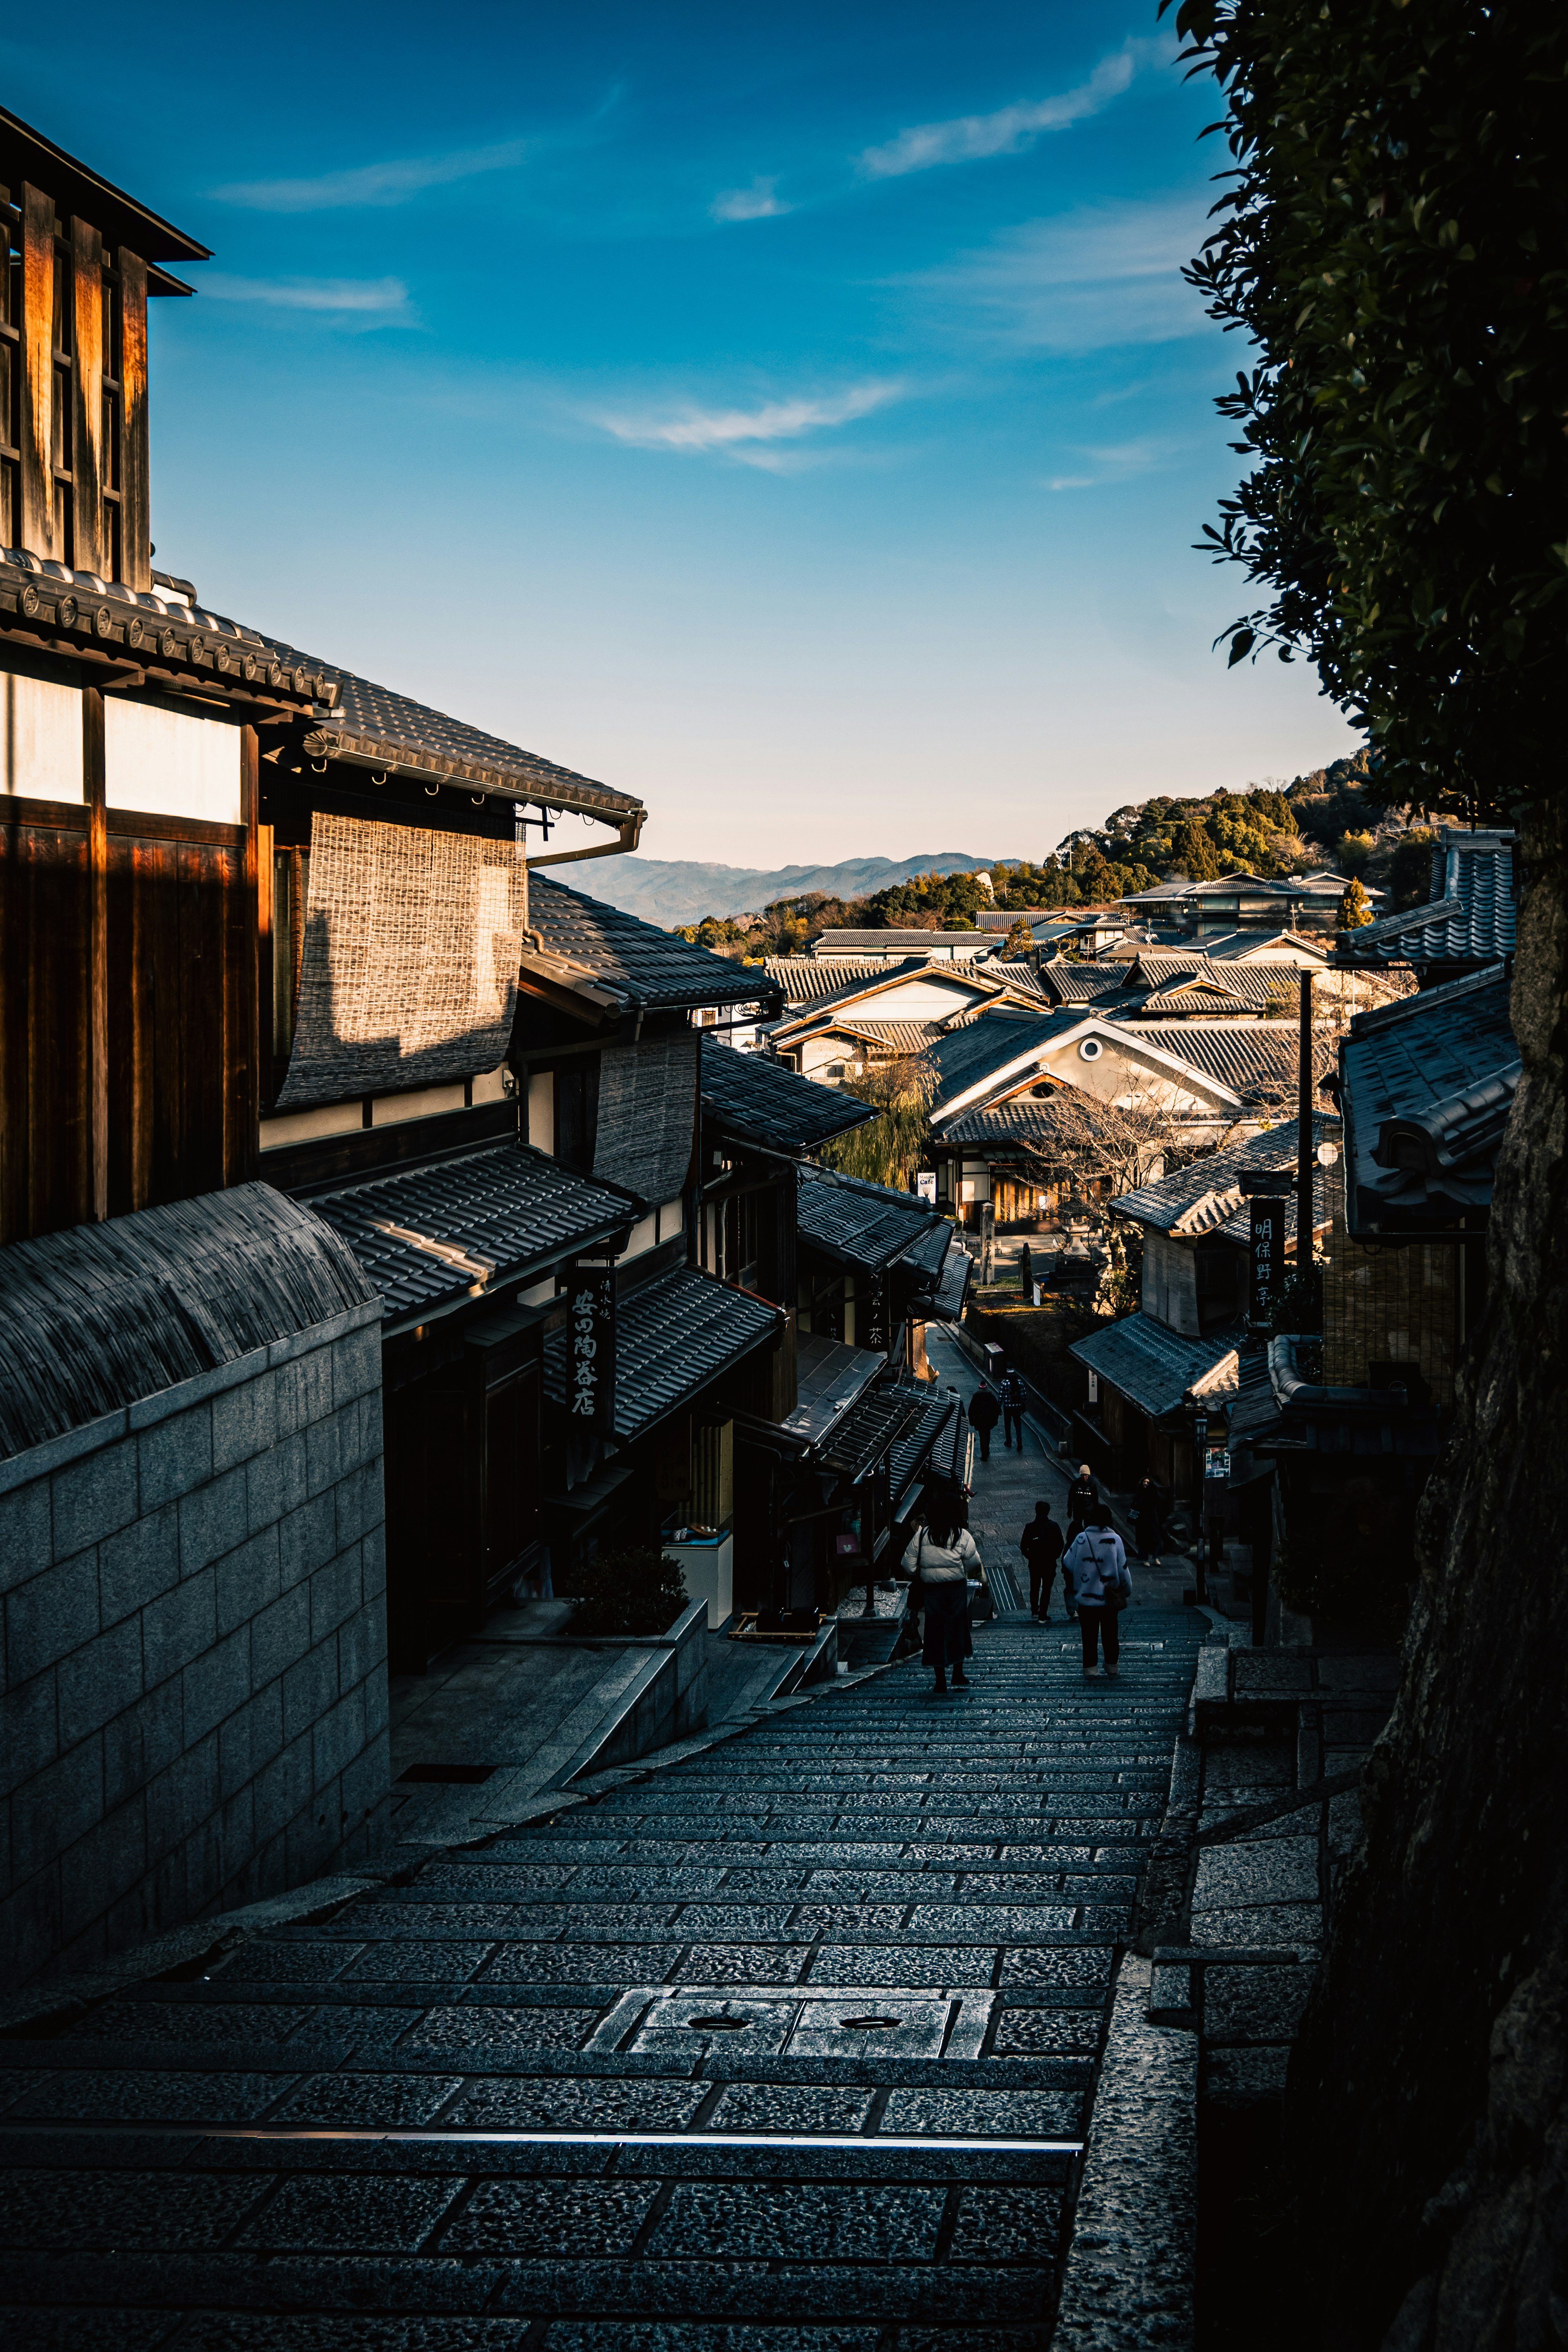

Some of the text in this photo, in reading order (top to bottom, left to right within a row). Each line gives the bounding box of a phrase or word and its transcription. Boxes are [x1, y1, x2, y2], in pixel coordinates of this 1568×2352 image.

[599, 1280, 612, 1319] 清水焼
[1255, 1218, 1272, 1306] 明保野亭
[572, 1289, 598, 1415] 安田陶器店
